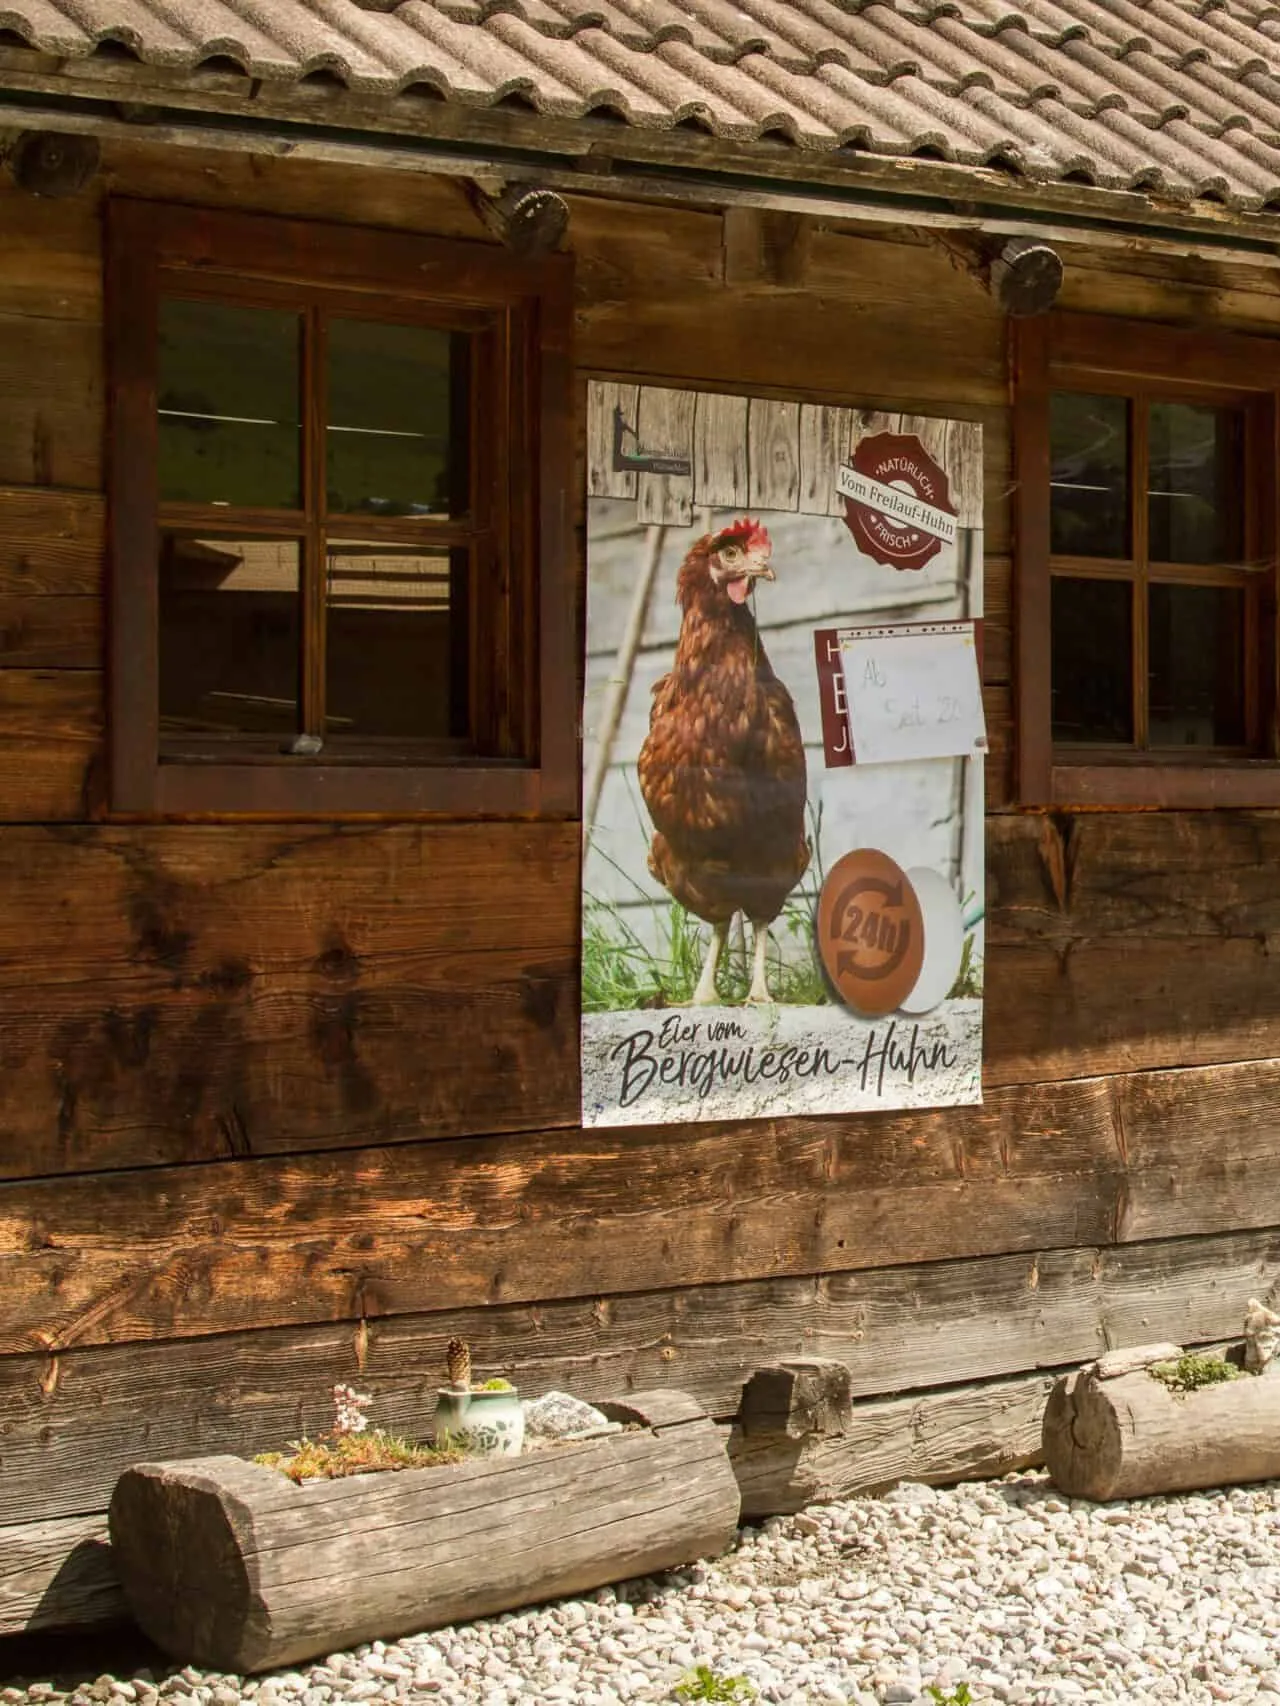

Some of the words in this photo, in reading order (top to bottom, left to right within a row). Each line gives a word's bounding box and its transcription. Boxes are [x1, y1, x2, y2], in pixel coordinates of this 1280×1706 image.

[878, 456, 934, 496] NATÜRLICH
[841, 471, 867, 497] Vom
[869, 488, 954, 536] Freilauf-Huhn
[874, 522, 912, 549] FRISCH
[843, 904, 897, 953] 24h
[658, 1014, 702, 1049] Eier
[707, 1020, 747, 1042] vom
[611, 1021, 957, 1108] Bergwiesen-Huhn
